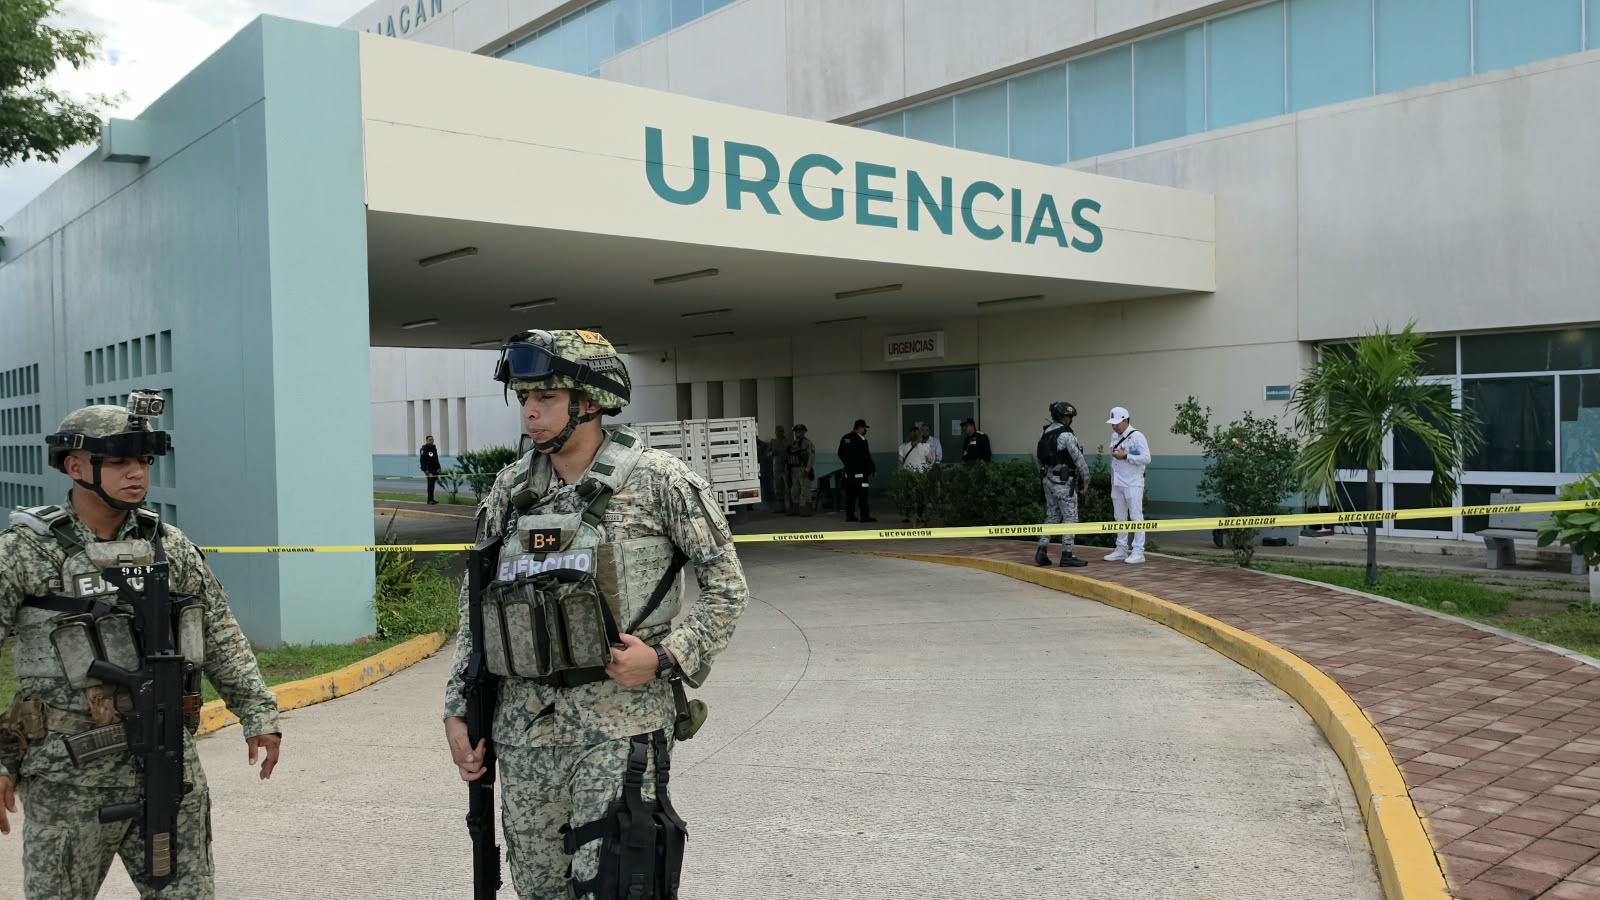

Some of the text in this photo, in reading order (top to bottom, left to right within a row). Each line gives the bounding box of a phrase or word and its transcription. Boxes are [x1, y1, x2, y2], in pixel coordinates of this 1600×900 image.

[645, 126, 1104, 253] URGENCIAS
[888, 339, 934, 355] URGENCIAS
[533, 533, 556, 549] B+
